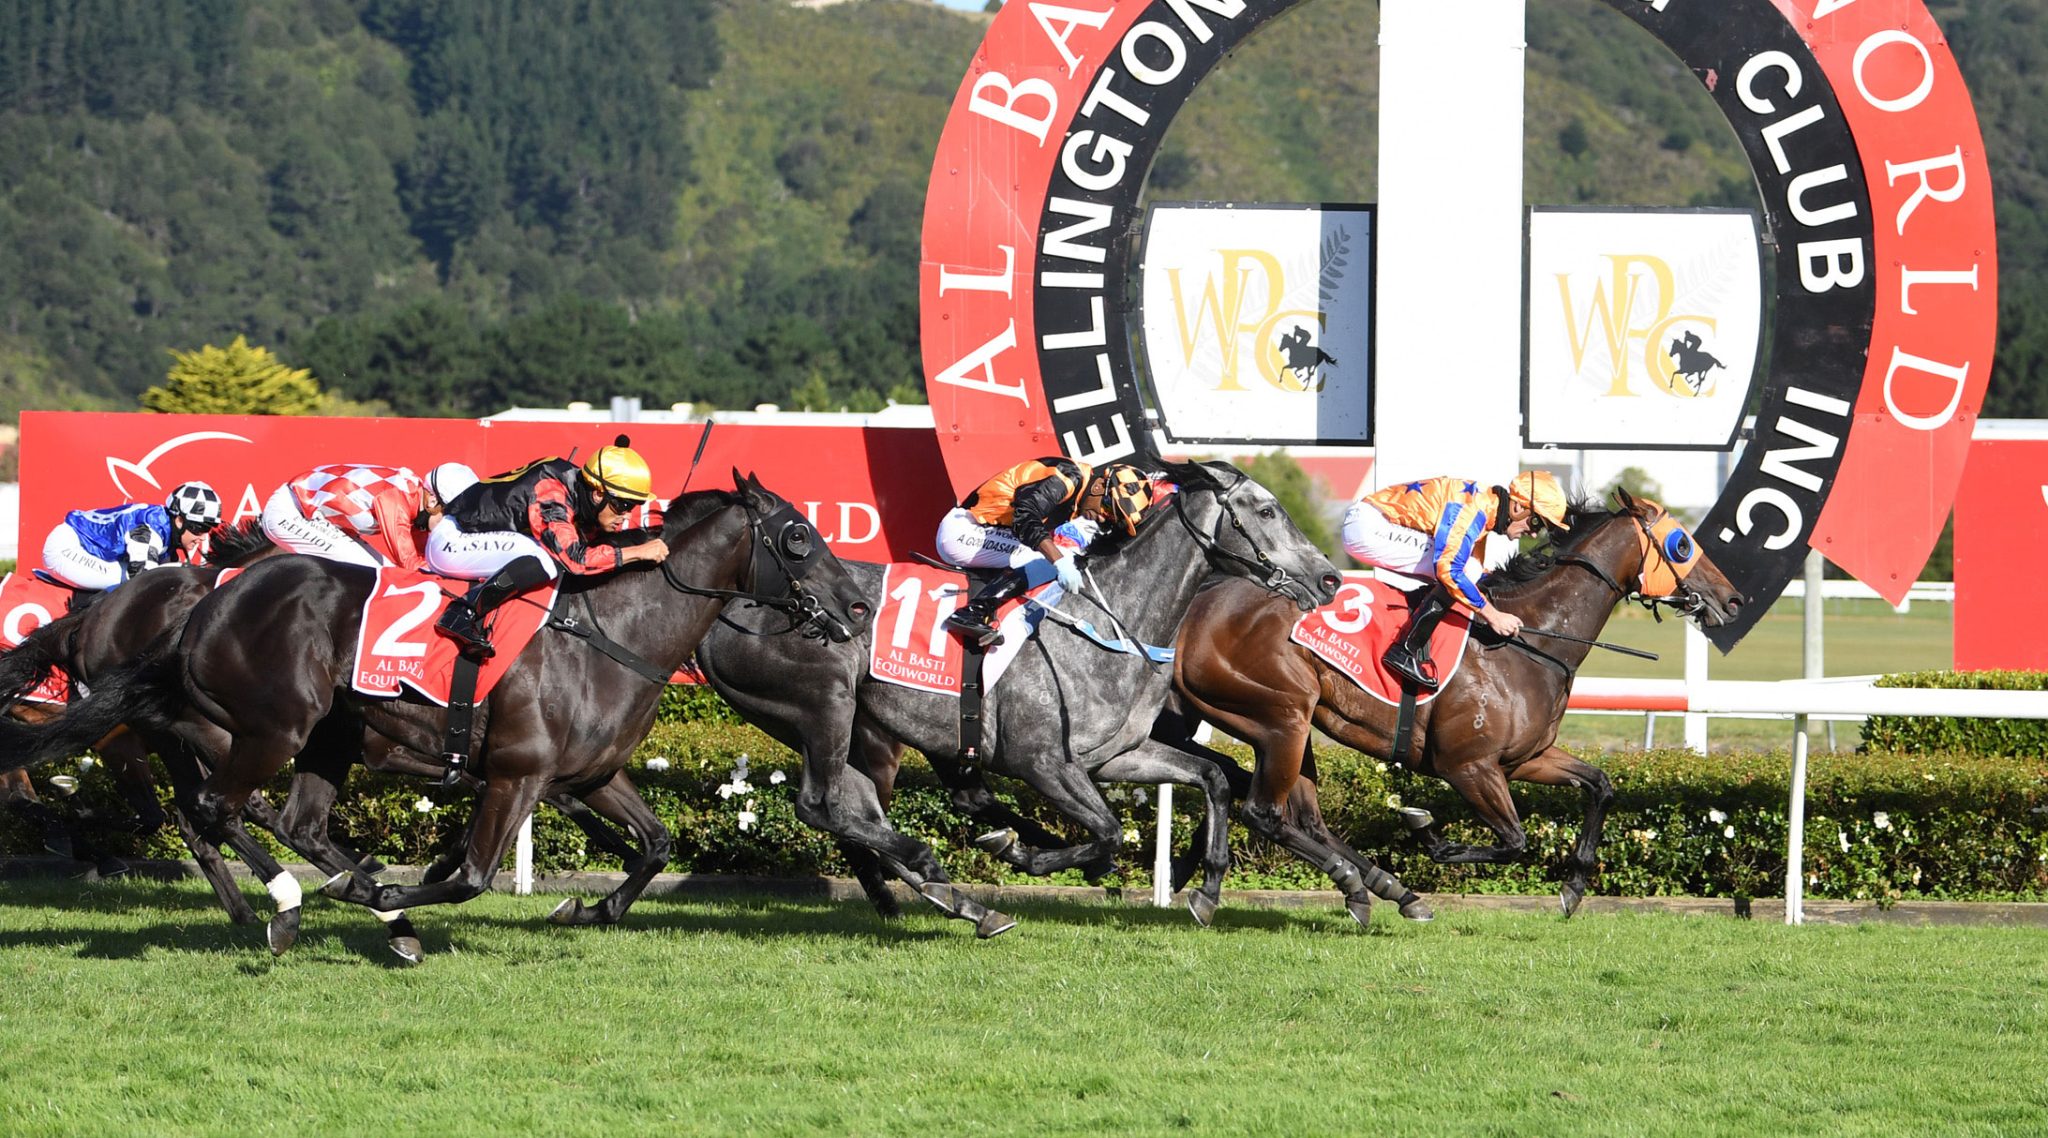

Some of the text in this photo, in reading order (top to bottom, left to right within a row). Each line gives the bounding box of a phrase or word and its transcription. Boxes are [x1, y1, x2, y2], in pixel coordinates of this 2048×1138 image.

[934, 0, 1978, 430] AL BA ORLD
[1041, 0, 1865, 550] ELLINGTON CLUB INC.
[371, 580, 443, 657] 2
[890, 577, 960, 657] 11
[1321, 582, 1375, 634] 3
[376, 659, 394, 671] AL
[889, 649, 946, 671] AL BASTI
[1298, 627, 1363, 675] EQUIWORLD
[1313, 625, 1361, 659] AL BASTI
[874, 656, 956, 687] EQUIWORLD
